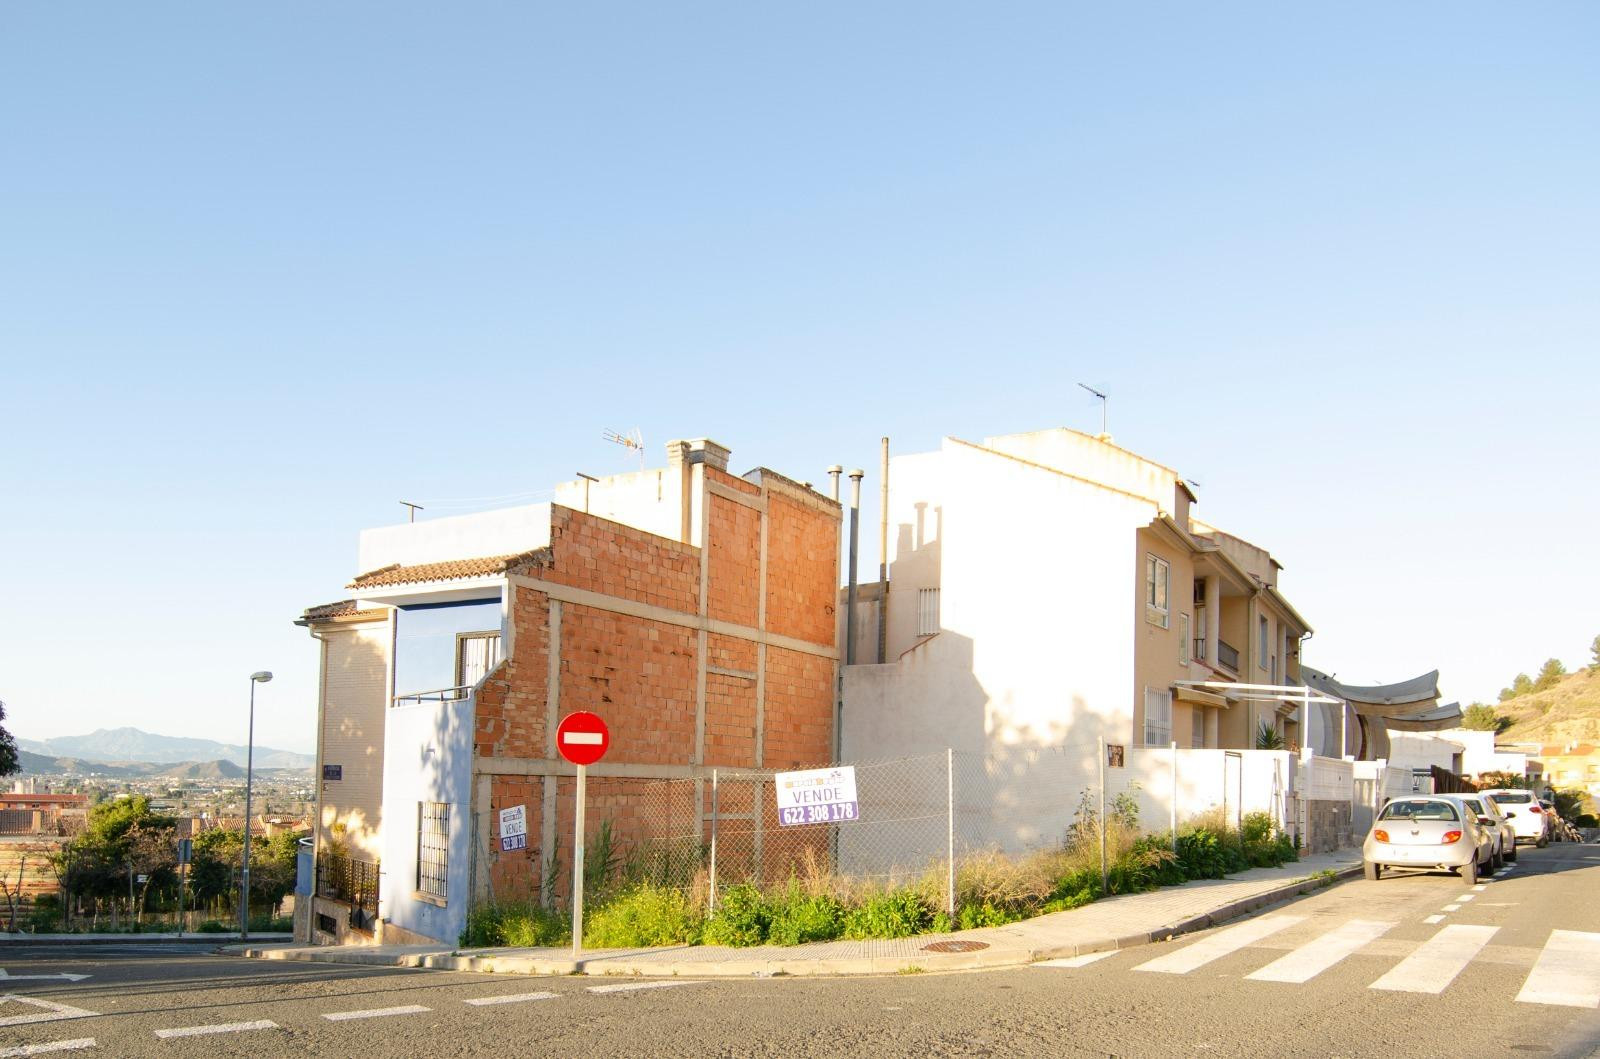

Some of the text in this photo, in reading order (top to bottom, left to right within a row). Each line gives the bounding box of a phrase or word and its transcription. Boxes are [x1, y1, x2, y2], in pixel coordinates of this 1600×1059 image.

[793, 788, 843, 803] VENDE
[784, 802, 853, 824] 622 308 178
